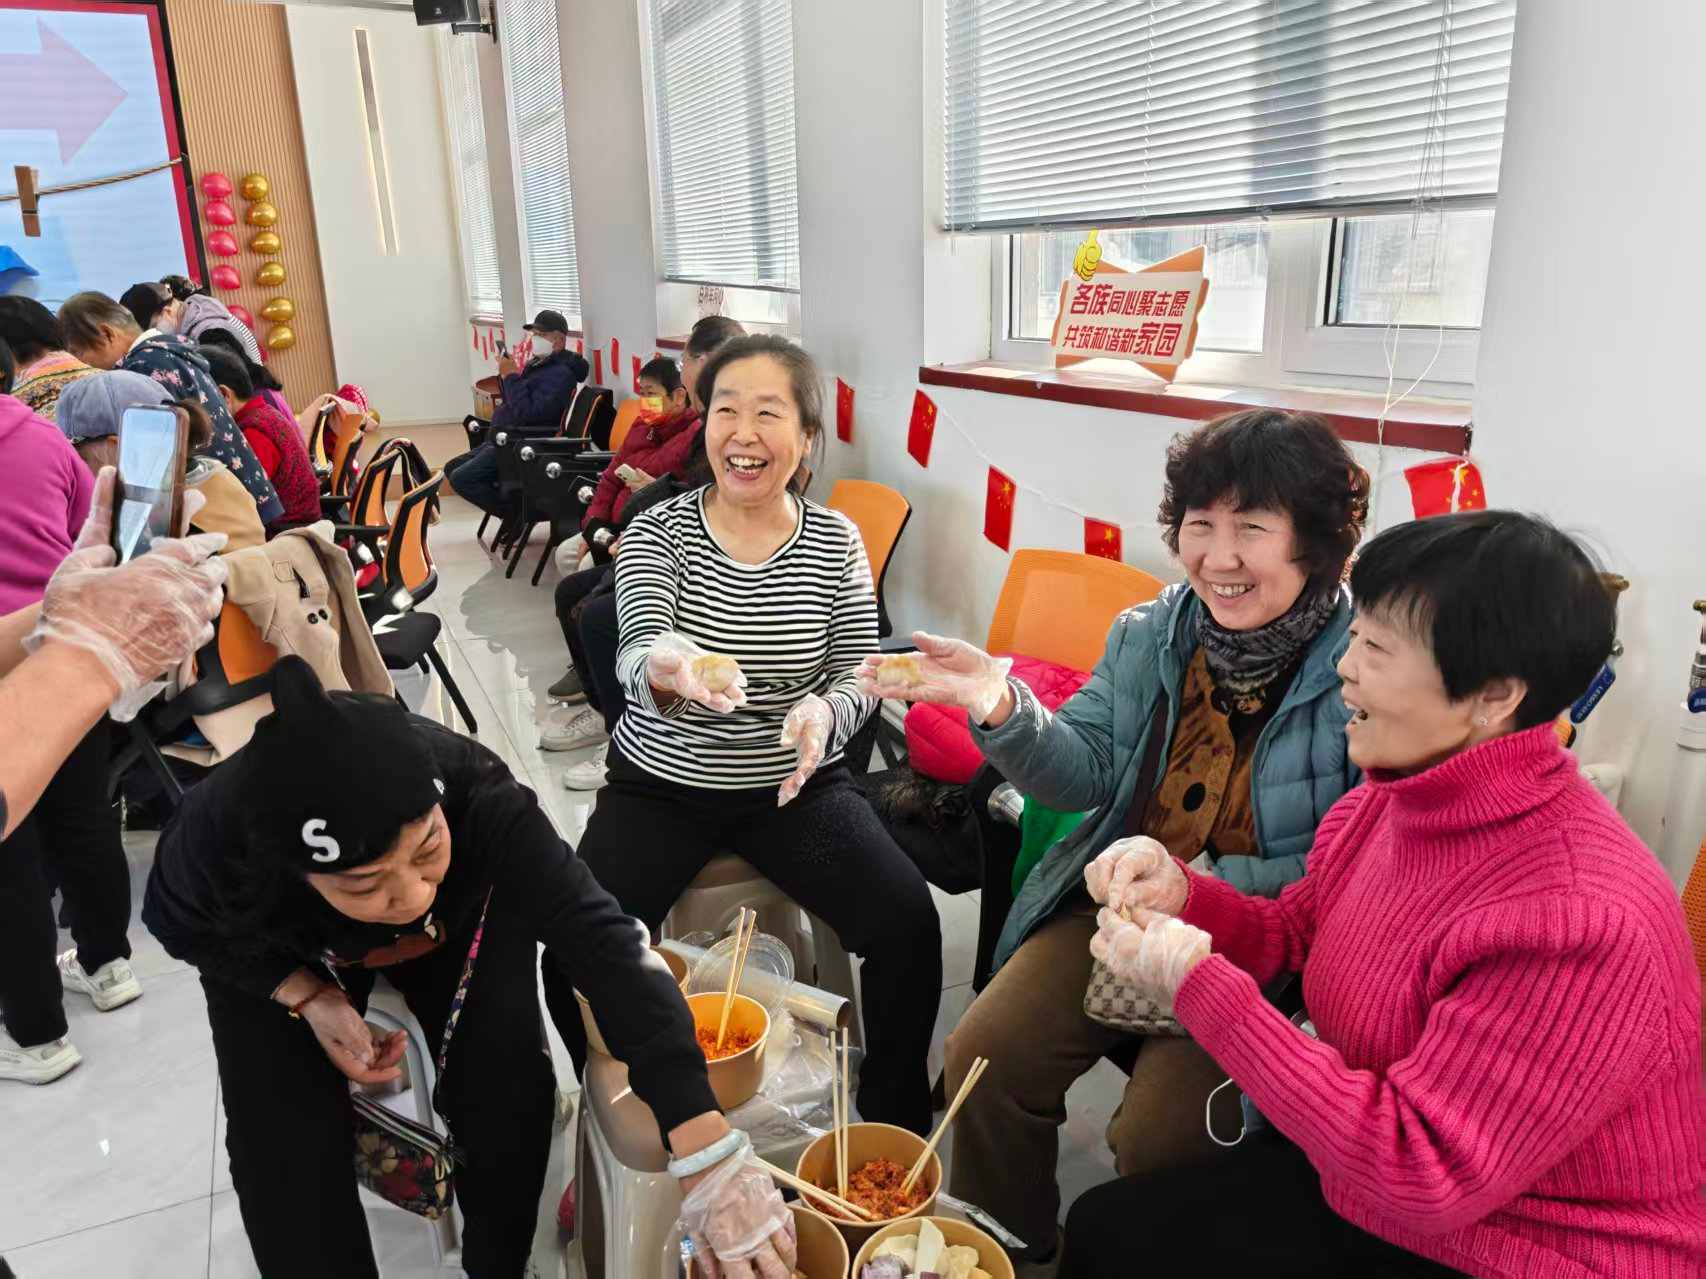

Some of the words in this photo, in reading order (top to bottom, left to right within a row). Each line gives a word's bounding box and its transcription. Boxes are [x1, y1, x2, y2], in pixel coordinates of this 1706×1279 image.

[1070, 284, 1190, 316] 各族同心聚志愿
[1063, 323, 1182, 356] 共筑和谐新家园
[302, 818, 341, 863] S
